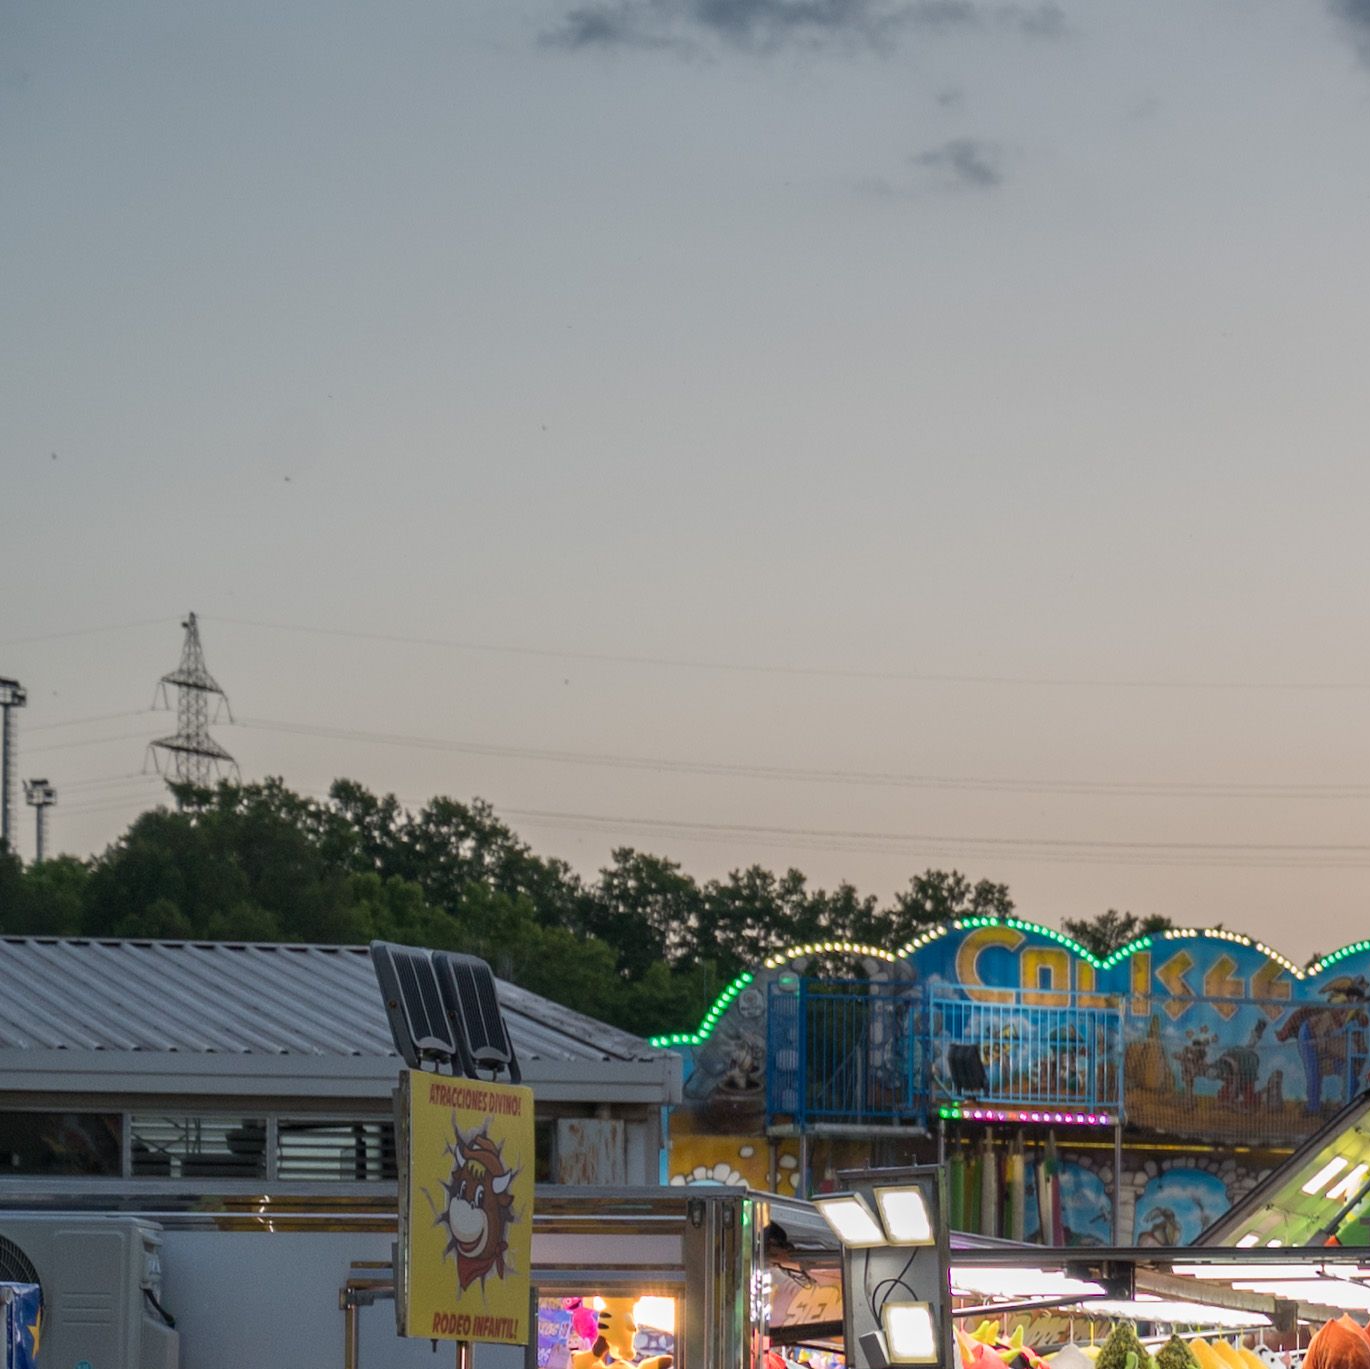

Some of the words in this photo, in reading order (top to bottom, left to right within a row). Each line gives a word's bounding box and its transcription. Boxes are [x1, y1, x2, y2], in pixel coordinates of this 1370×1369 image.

[429, 1084, 488, 1112] ATRACCIONES
[488, 1092, 522, 1116] DIVINO!
[432, 1313, 471, 1336] RODEO
[473, 1315, 519, 1340] INFANTIL!
